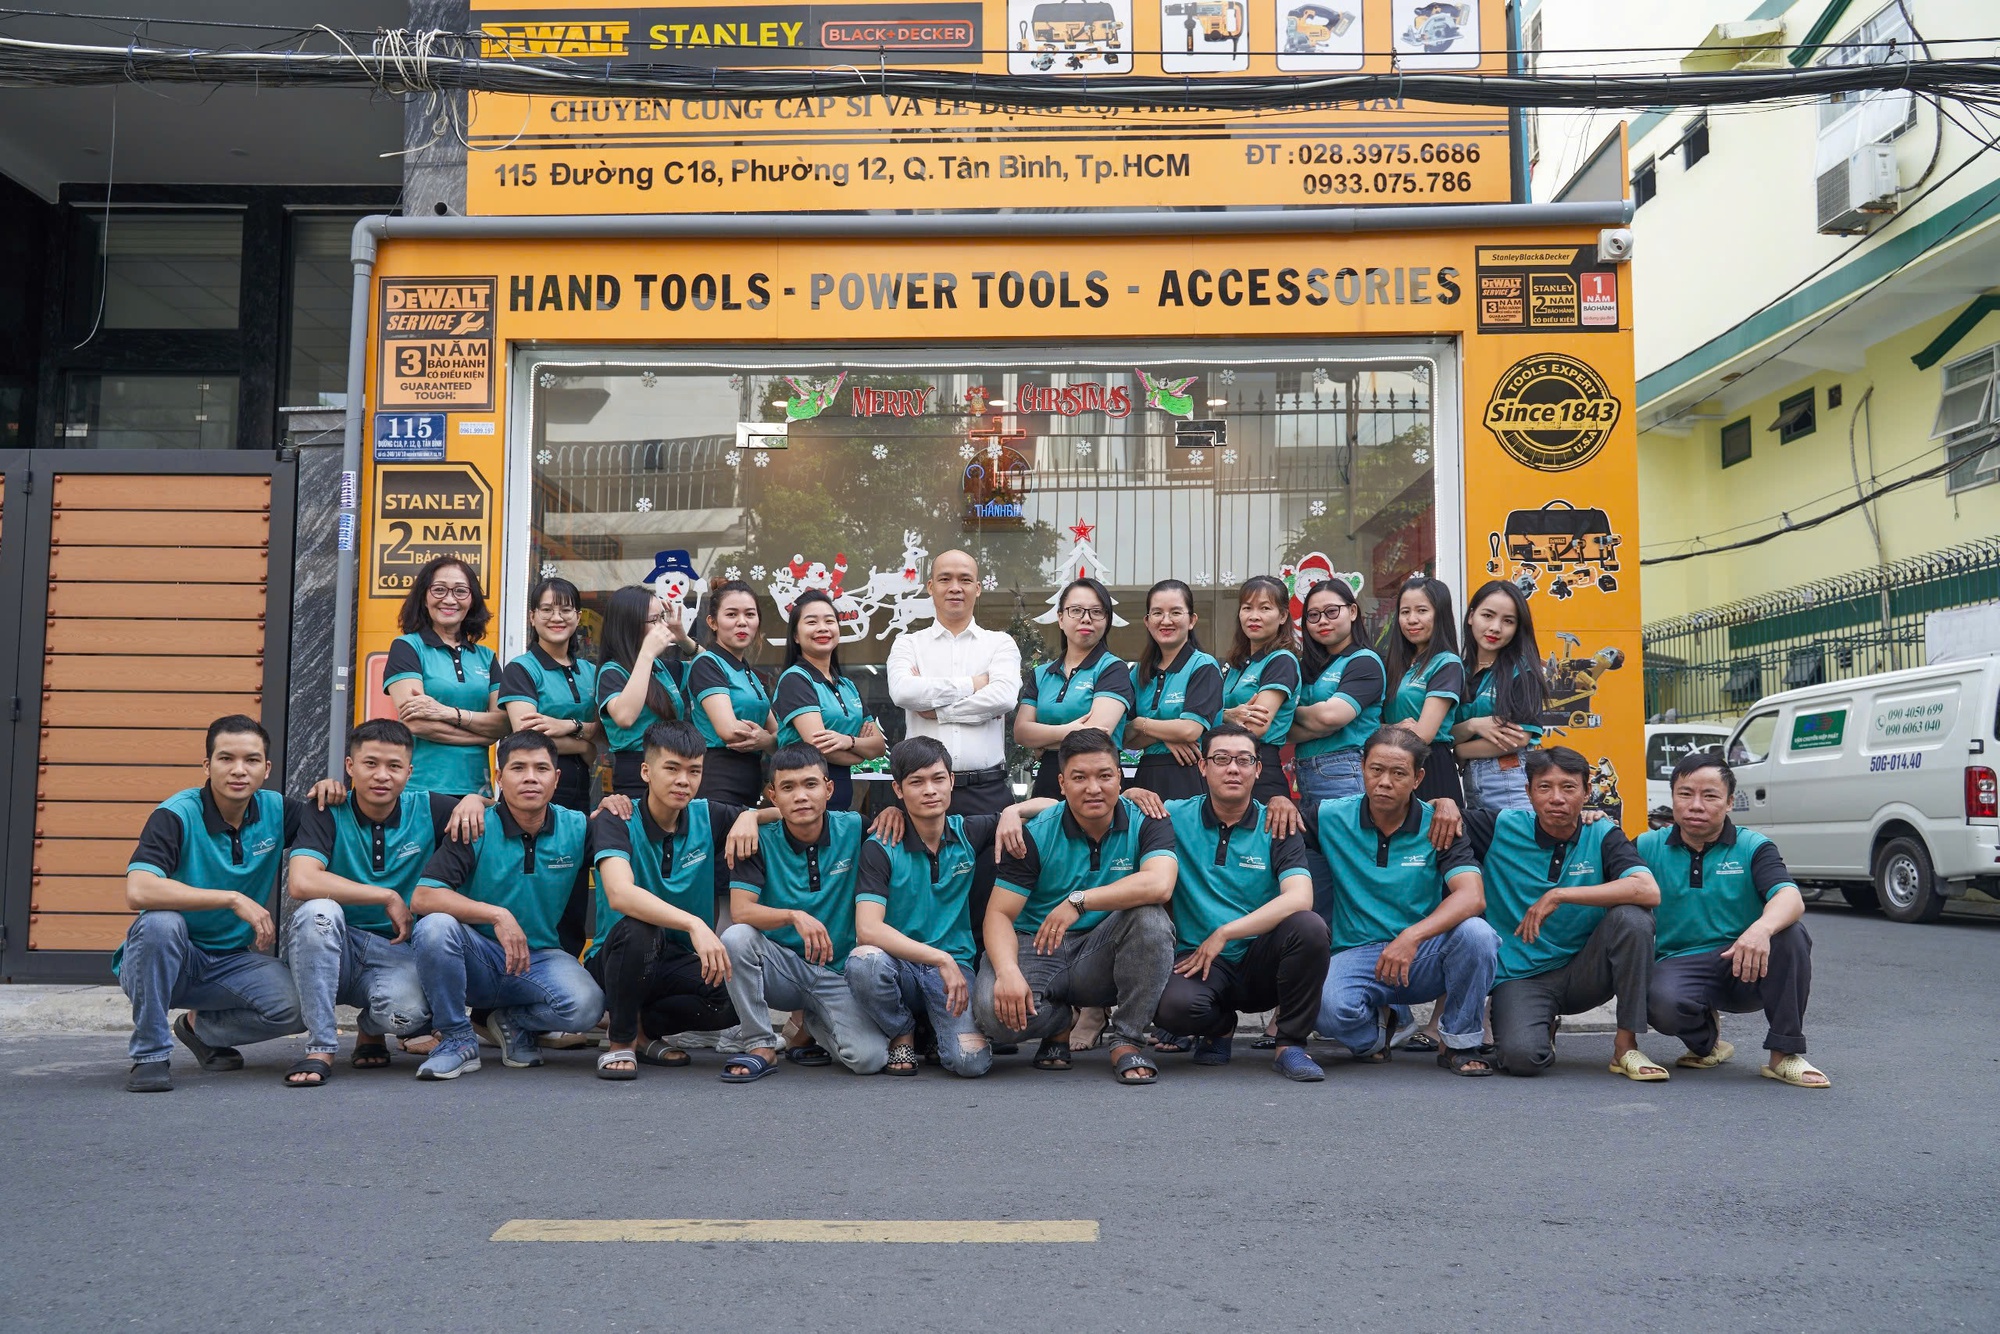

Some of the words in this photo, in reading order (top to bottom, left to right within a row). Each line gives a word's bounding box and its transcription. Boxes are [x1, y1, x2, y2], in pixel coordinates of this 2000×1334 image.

[649, 22, 804, 51] STANLEY
[829, 27, 966, 42] BLACK+DECKER
[494, 162, 537, 187] 115
[550, 160, 654, 190] Đường
[663, 159, 723, 188] C18,
[731, 157, 849, 187] Phường
[858, 156, 895, 184] 12,
[903, 156, 934, 183] Q.
[943, 154, 989, 181] Tân
[1000, 154, 1069, 182] Bình,
[1303, 171, 1472, 194] 0933.075.786
[1491, 252, 1570, 262] StanleyBlack&Decker
[508, 273, 621, 312] HAND
[634, 273, 771, 311] TOOLS
[810, 271, 958, 310] POWER
[971, 269, 1110, 309] TOOLS
[1158, 266, 1462, 307] ACCESSORIES
[1593, 276, 1603, 294] 1
[1488, 302, 1498, 313] 3
[1534, 296, 1547, 313] 2
[386, 313, 457, 332] SERVICE
[430, 340, 487, 357] NĂM
[400, 349, 422, 376] 3
[427, 356, 451, 369] BẢO
[452, 356, 485, 369] HÀNH
[427, 369, 440, 379] CÓ
[463, 369, 485, 380] KIỆN
[1508, 364, 1548, 393] TOOLS
[1551, 363, 1598, 394] EXPERT
[400, 381, 472, 391] GUARANTEED
[851, 384, 937, 418] MERRY
[1016, 381, 1132, 419] CHRISTMAS
[1490, 402, 1556, 422] Since
[1560, 402, 1614, 422] 1843
[388, 417, 432, 438] 115
[384, 493, 480, 510] STANLEY
[422, 521, 481, 542] NĂM
[383, 520, 414, 565] 2
[379, 573, 399, 588] CÓ
[1888, 708, 1903, 721] 090
[1904, 706, 1925, 719] 4050
[1926, 703, 1943, 716] 699
[1885, 724, 1901, 736] 090
[1902, 721, 1923, 735] 6063
[1924, 719, 1941, 731] 040
[1870, 752, 1922, 772] 50G-014.40
